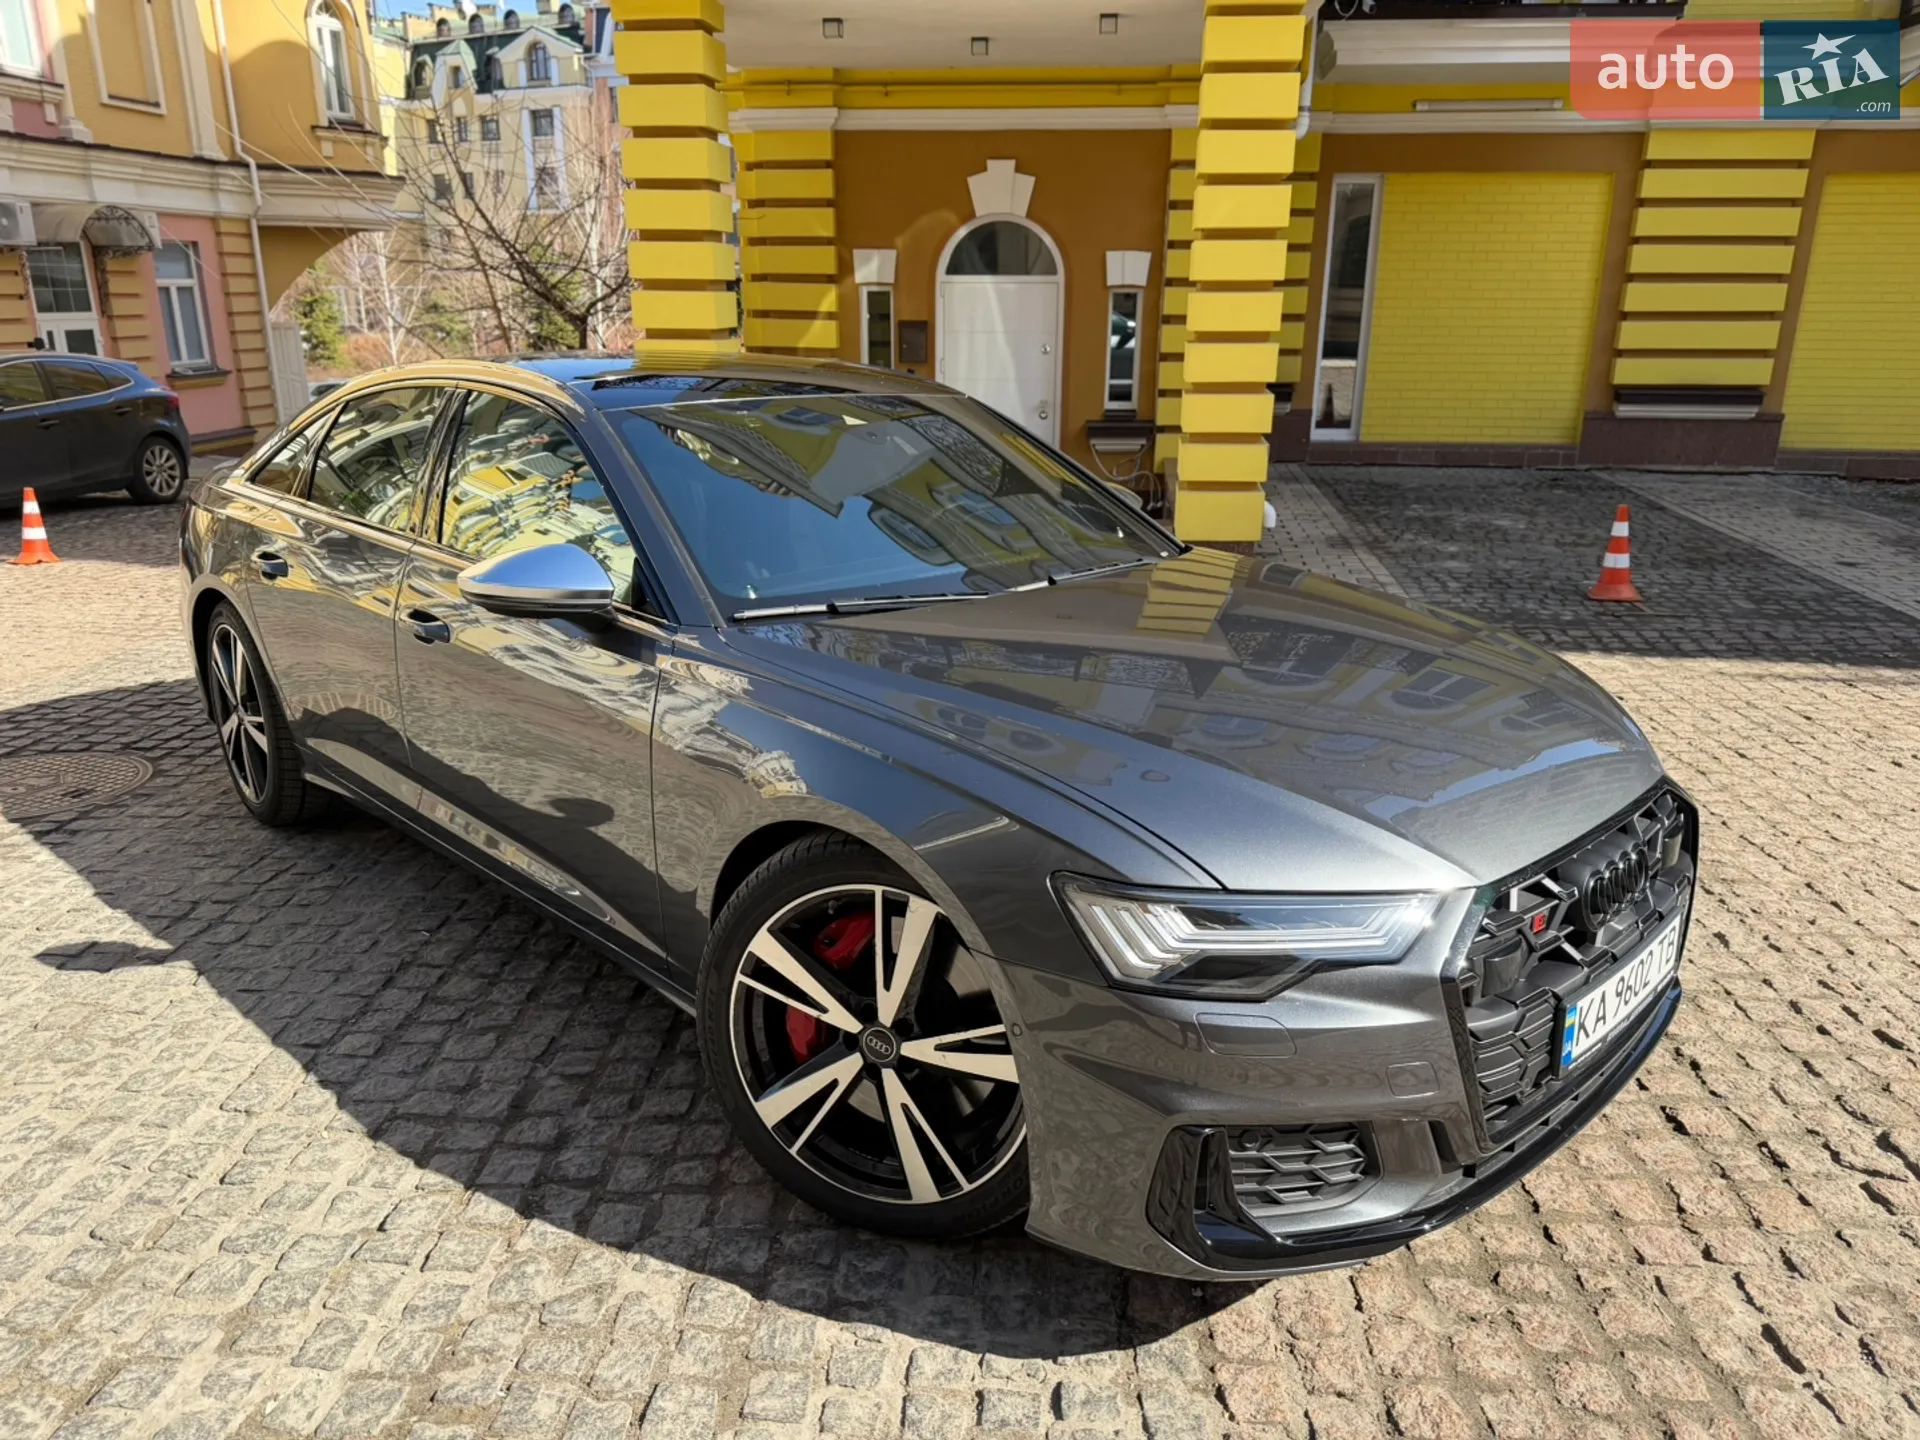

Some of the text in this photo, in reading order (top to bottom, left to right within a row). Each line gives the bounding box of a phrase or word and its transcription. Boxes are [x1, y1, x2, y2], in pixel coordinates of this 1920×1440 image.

[1576, 989, 1607, 1047] KA
[1613, 949, 1654, 1019] 9602
[1657, 924, 1677, 975] TB
